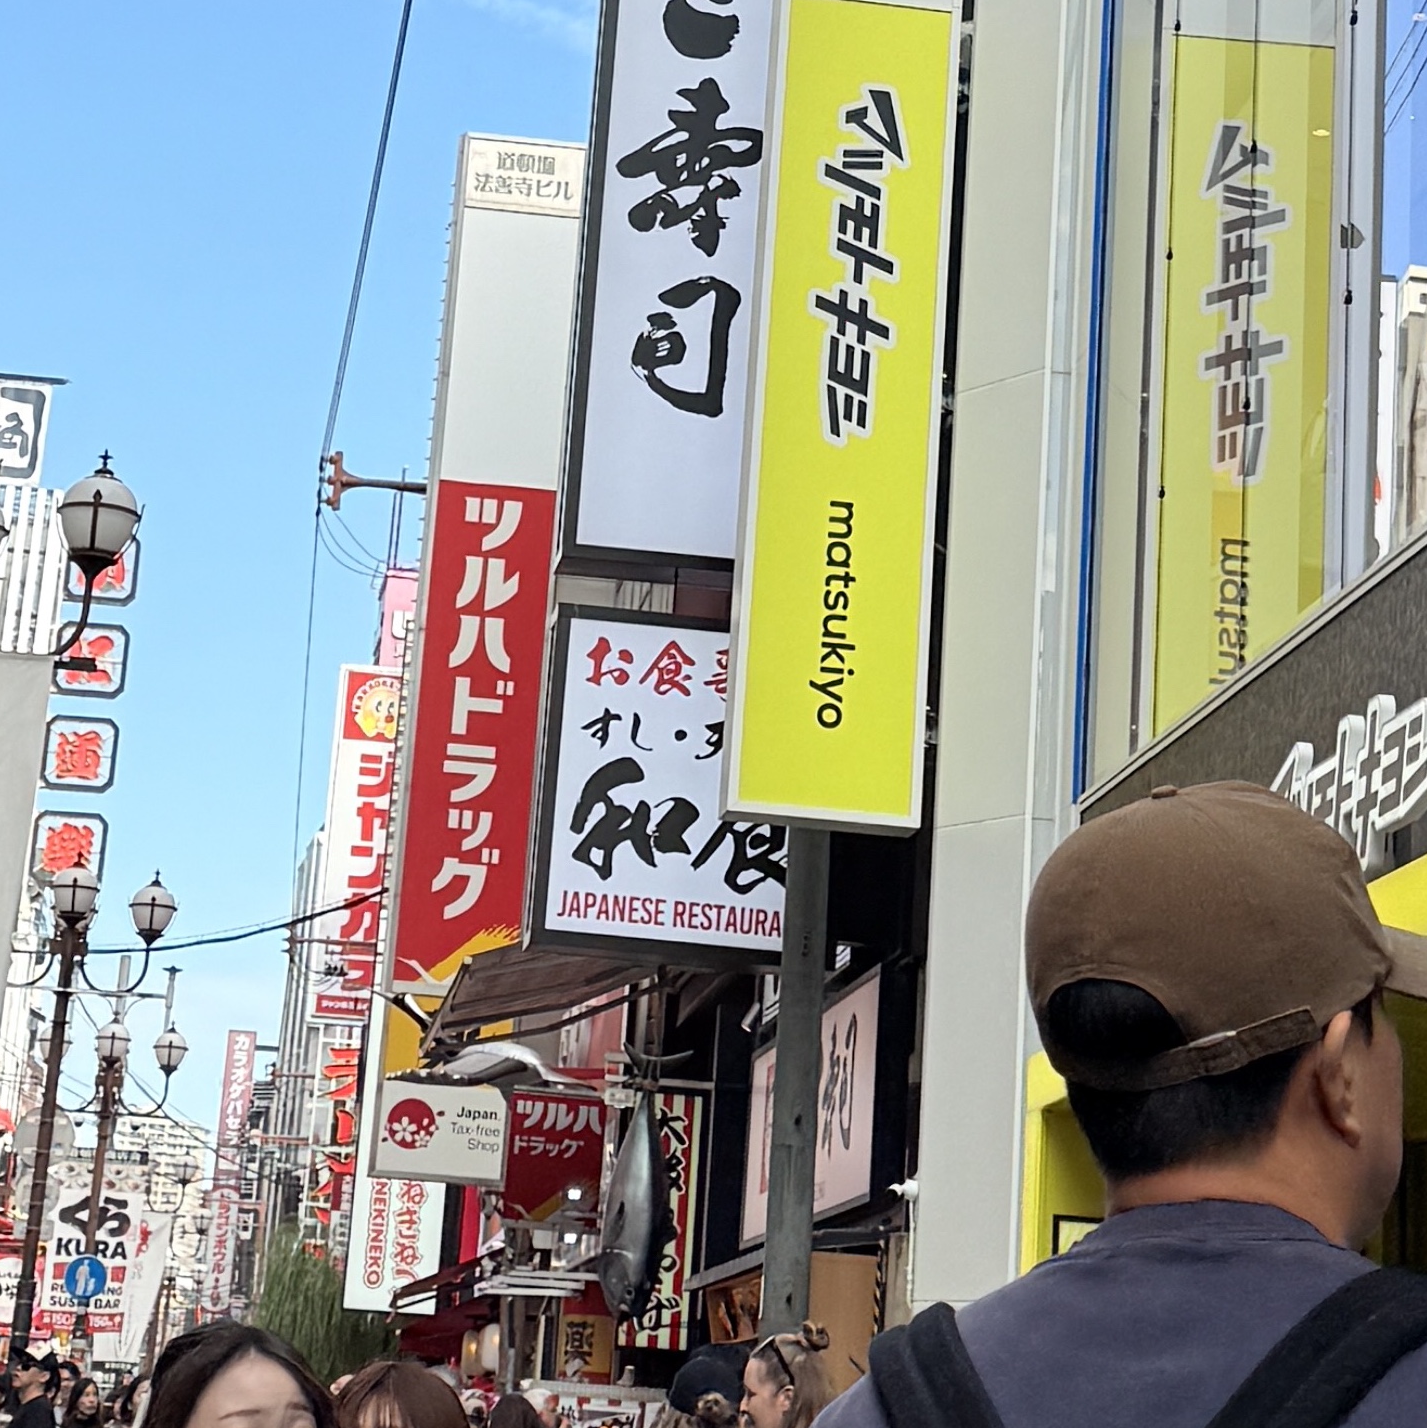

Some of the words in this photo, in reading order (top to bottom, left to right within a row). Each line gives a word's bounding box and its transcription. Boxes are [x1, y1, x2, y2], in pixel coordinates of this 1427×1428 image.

[809, 500, 857, 730] matsukiyo
[431, 496, 523, 920] ツルハドラッグ
[557, 890, 665, 926] JAPANESE
[516, 1099, 604, 1135] ツルハ
[468, 1139, 500, 1155] Shop
[513, 1139, 584, 1160] ドラッグ
